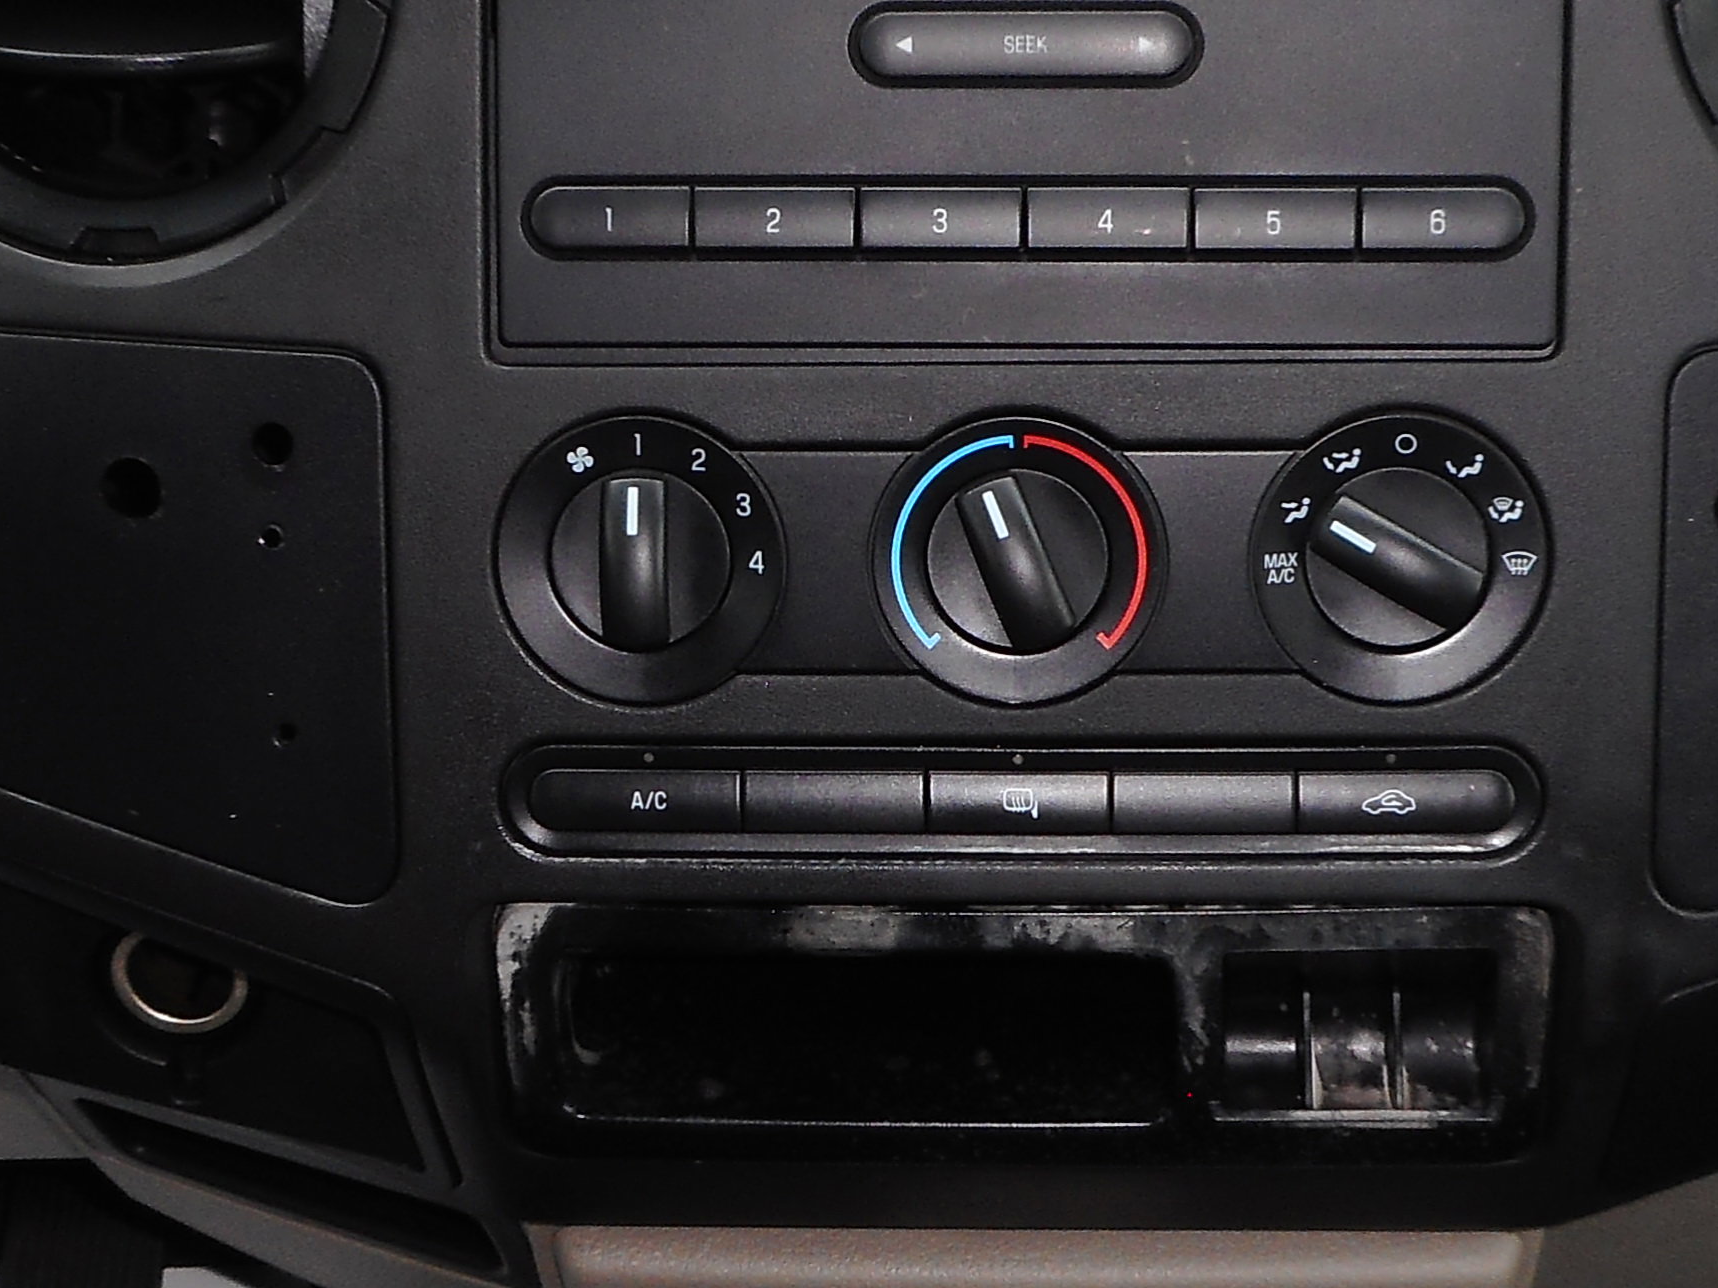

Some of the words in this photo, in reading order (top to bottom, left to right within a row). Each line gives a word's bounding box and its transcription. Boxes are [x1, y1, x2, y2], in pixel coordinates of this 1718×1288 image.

[1003, 35, 1048, 54] SEEK
[605, 207, 614, 232] 1
[766, 208, 781, 234] 2
[932, 208, 949, 234] 3
[1097, 208, 1114, 235] 4
[1265, 210, 1282, 235] 5
[1429, 209, 1447, 235] 6
[633, 433, 642, 456] 1
[691, 448, 707, 471] 2
[735, 493, 751, 517] 3
[748, 550, 765, 575] 4
[1263, 552, 1298, 570] MAX
[1267, 569, 1296, 584] A/C
[630, 790, 667, 810] A/C
